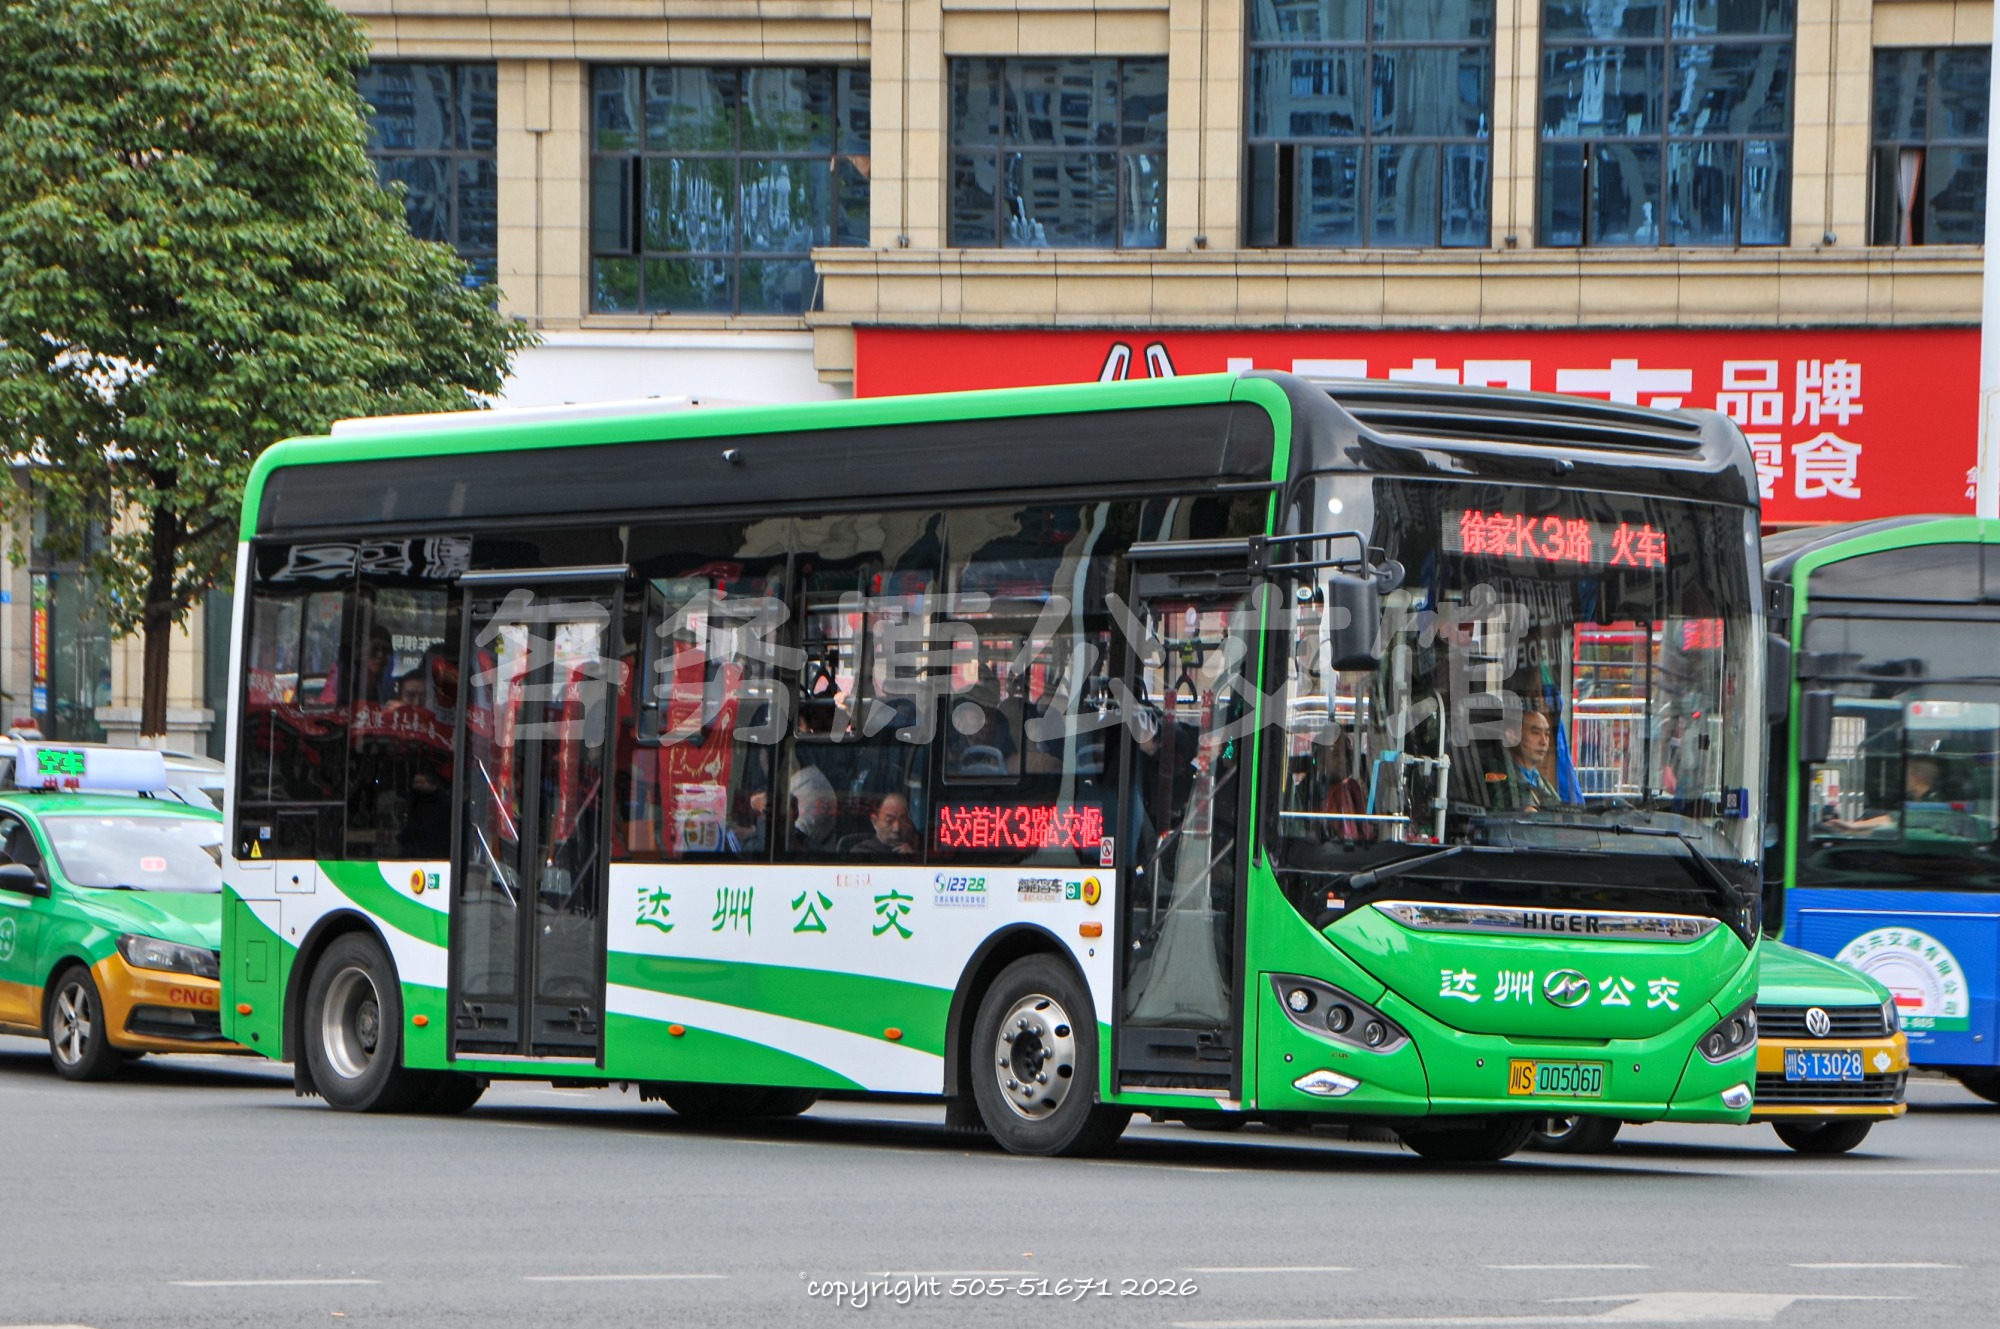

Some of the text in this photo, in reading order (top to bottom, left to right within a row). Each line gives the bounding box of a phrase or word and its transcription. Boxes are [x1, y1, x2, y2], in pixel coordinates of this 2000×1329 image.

[1716, 359, 1863, 426] 品牌
[1461, 510, 1666, 567] 徐家K3路 火车
[36, 748, 86, 777] 空车
[635, 886, 914, 939] 达州公交
[1523, 912, 1599, 933] HIGER
[169, 987, 214, 1005] CNG
